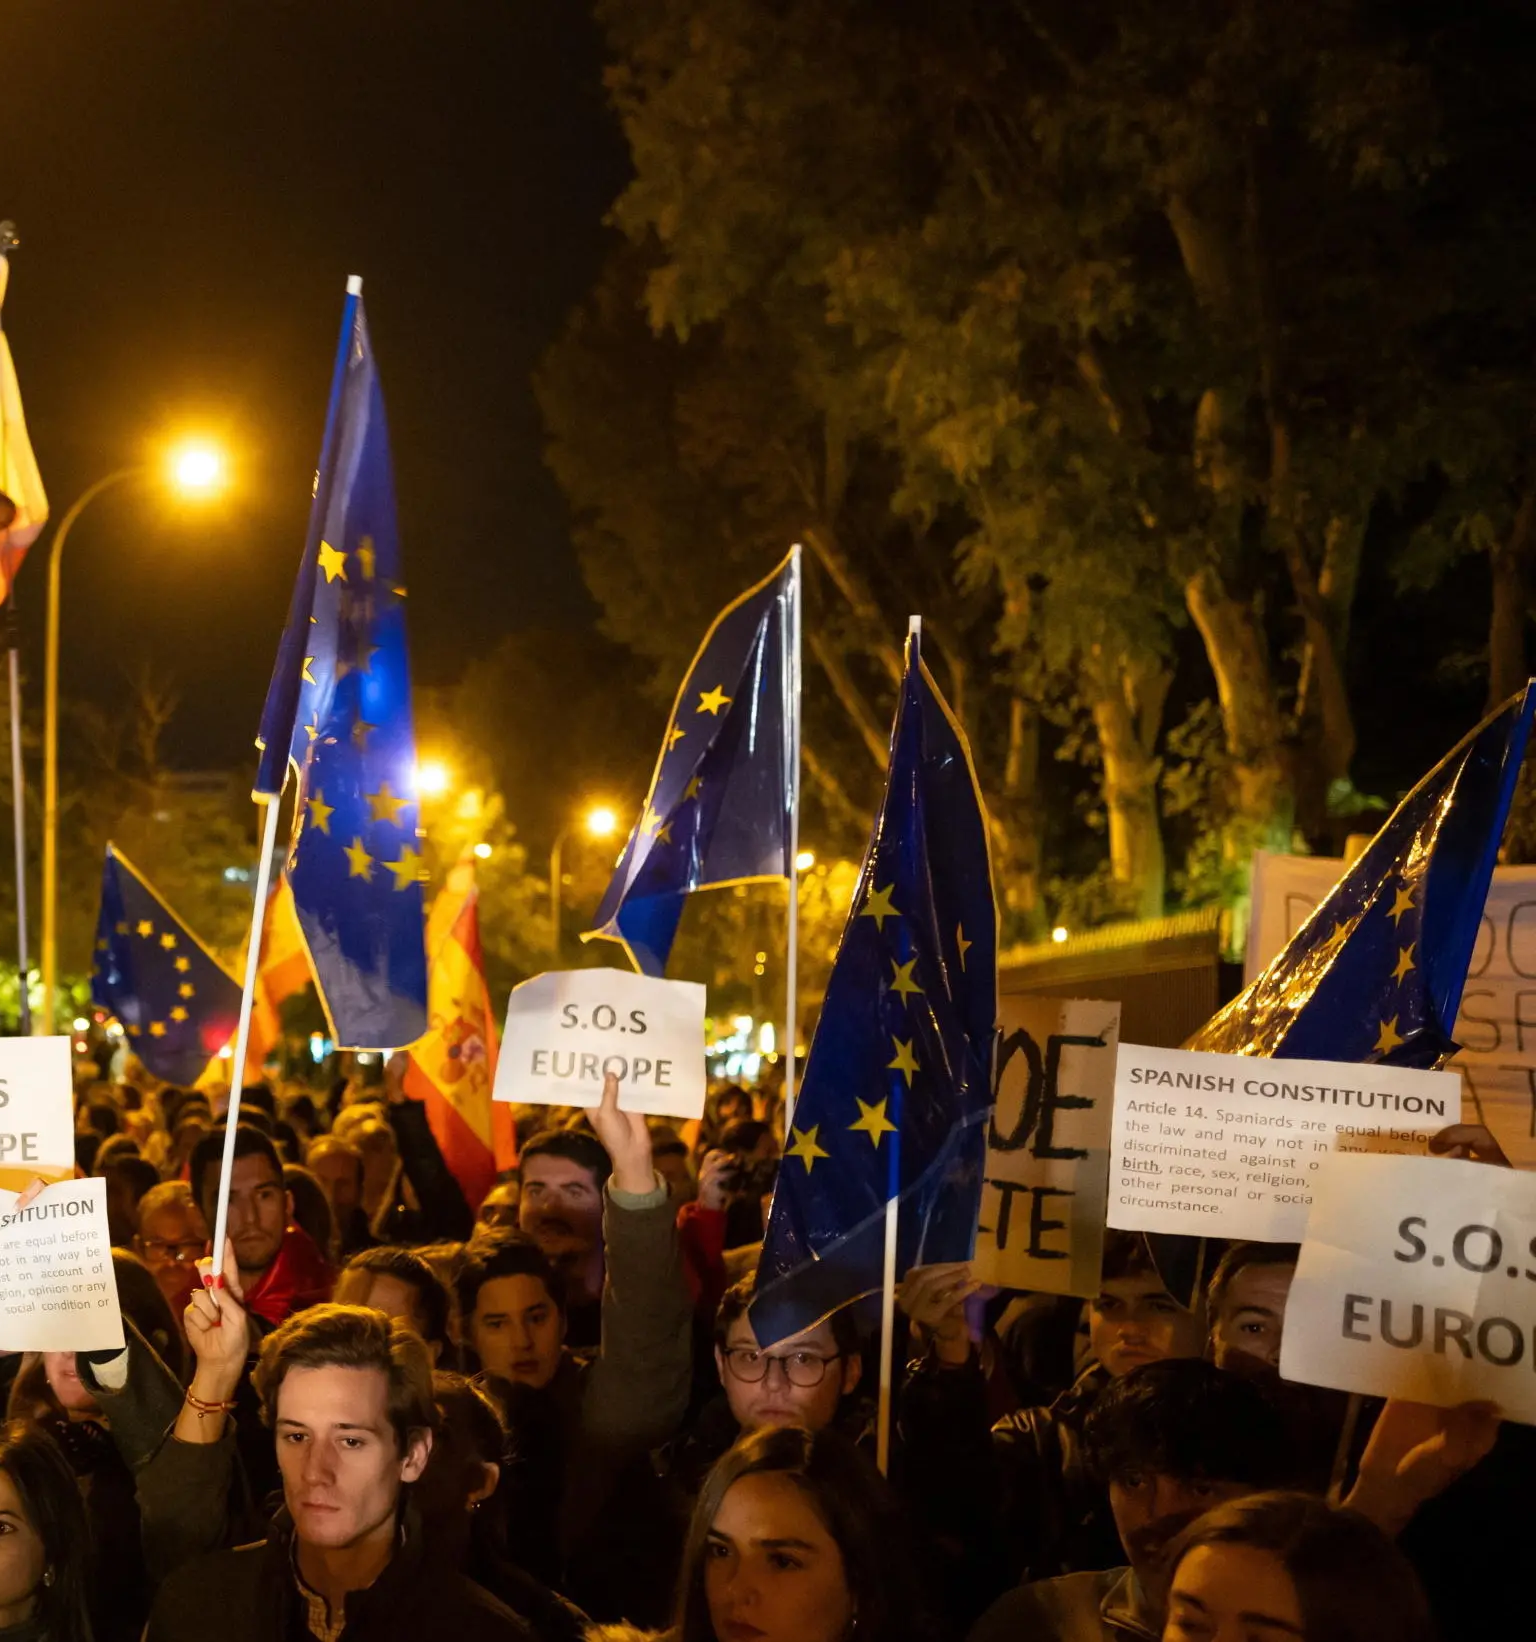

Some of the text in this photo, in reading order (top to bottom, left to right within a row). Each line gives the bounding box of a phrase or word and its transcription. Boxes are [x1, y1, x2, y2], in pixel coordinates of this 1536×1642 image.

[561, 1003, 647, 1034] S.O.S
[530, 1049, 672, 1087] EUROPE
[1129, 1067, 1235, 1093] SPANISH
[1243, 1079, 1445, 1117] CONSTITUTION
[1125, 1120, 1150, 1133] the
[1159, 1123, 1186, 1137] law
[1195, 1129, 1224, 1141] and
[1233, 1133, 1266, 1148] may
[1276, 1138, 1304, 1150] not
[1314, 1140, 1328, 1152] in
[1127, 1099, 1436, 1143] Article 14. Spaniards are equal befor
[1124, 1139, 1319, 1170] discriminated against o
[1122, 1156, 1310, 1187] birth, race, sex, religion,
[1119, 1195, 1224, 1214] circumstance.
[1121, 1177, 1313, 1204] other personal or socia
[977, 1178, 1076, 1259] TE
[4, 1240, 21, 1250] are
[25, 1234, 56, 1248] equal
[61, 1230, 98, 1243] before
[16, 1256, 26, 1265] in
[33, 1254, 51, 1264] any
[58, 1250, 80, 1261] way
[86, 1247, 101, 1258] be
[18, 1272, 33, 1281] on
[41, 1267, 83, 1278] account
[92, 1263, 104, 1274] of
[28, 1284, 69, 1297] opinion
[72, 1284, 83, 1293] or
[87, 1281, 106, 1293] any
[5, 1302, 35, 1315] social
[41, 1299, 91, 1311] condition
[98, 1297, 109, 1308] or
[1342, 1293, 1536, 1373] EURO
